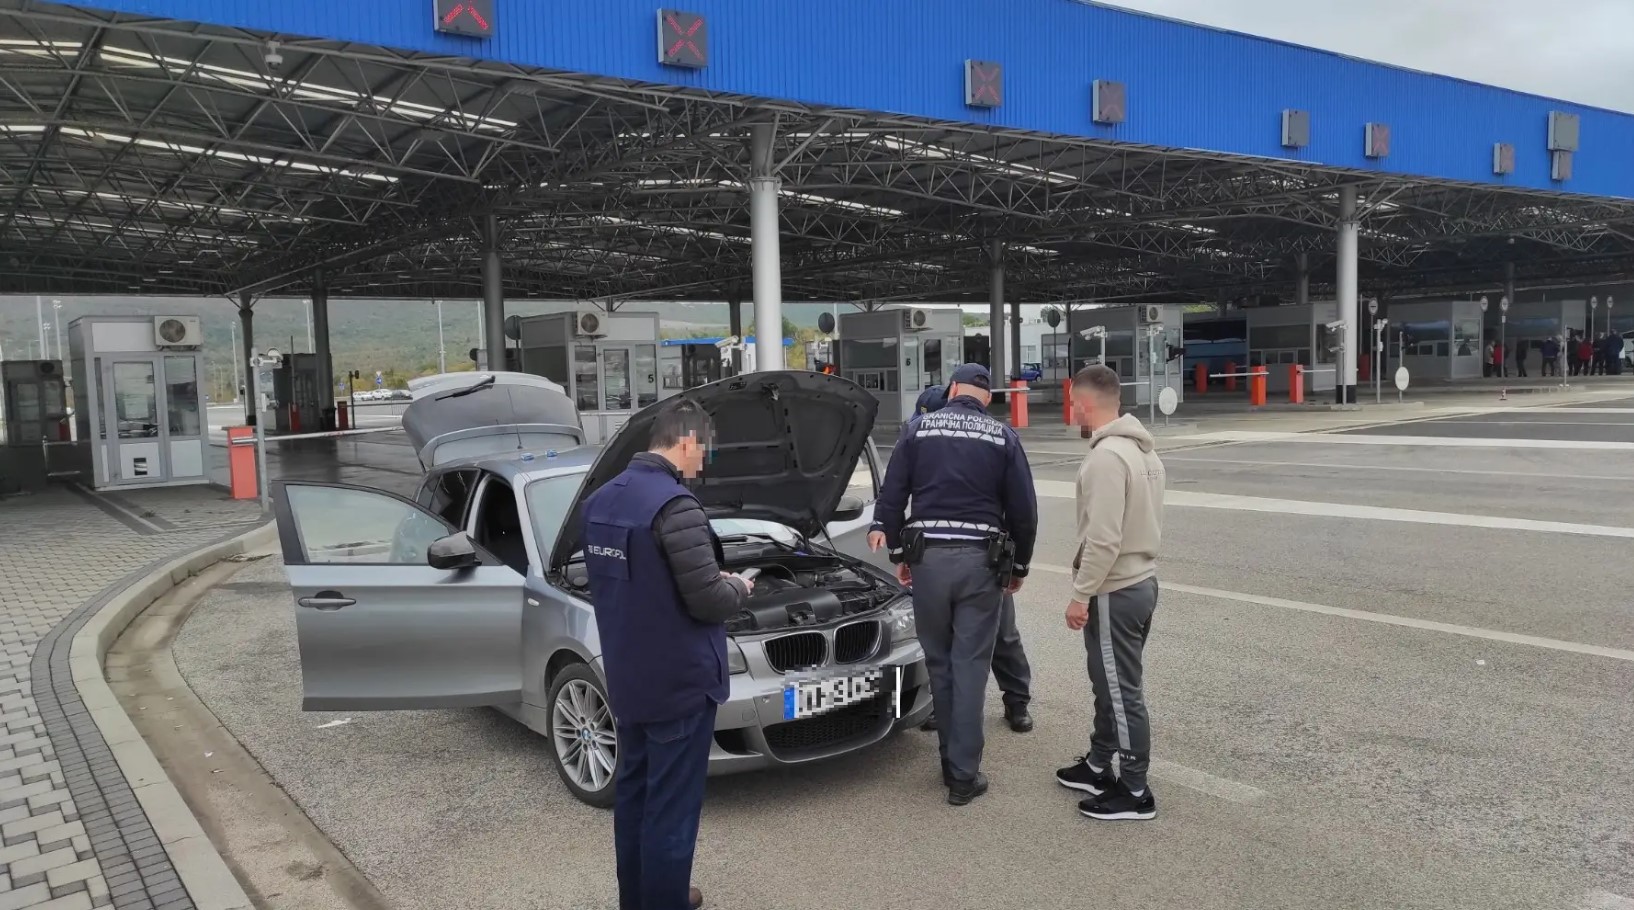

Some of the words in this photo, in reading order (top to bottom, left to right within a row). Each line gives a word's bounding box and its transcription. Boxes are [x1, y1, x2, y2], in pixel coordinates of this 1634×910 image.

[906, 358, 911, 366] 6
[648, 374, 654, 383] 5
[921, 420, 961, 430] ГРАНИЧНА
[962, 421, 1003, 436] ПОЛИЦИЈА
